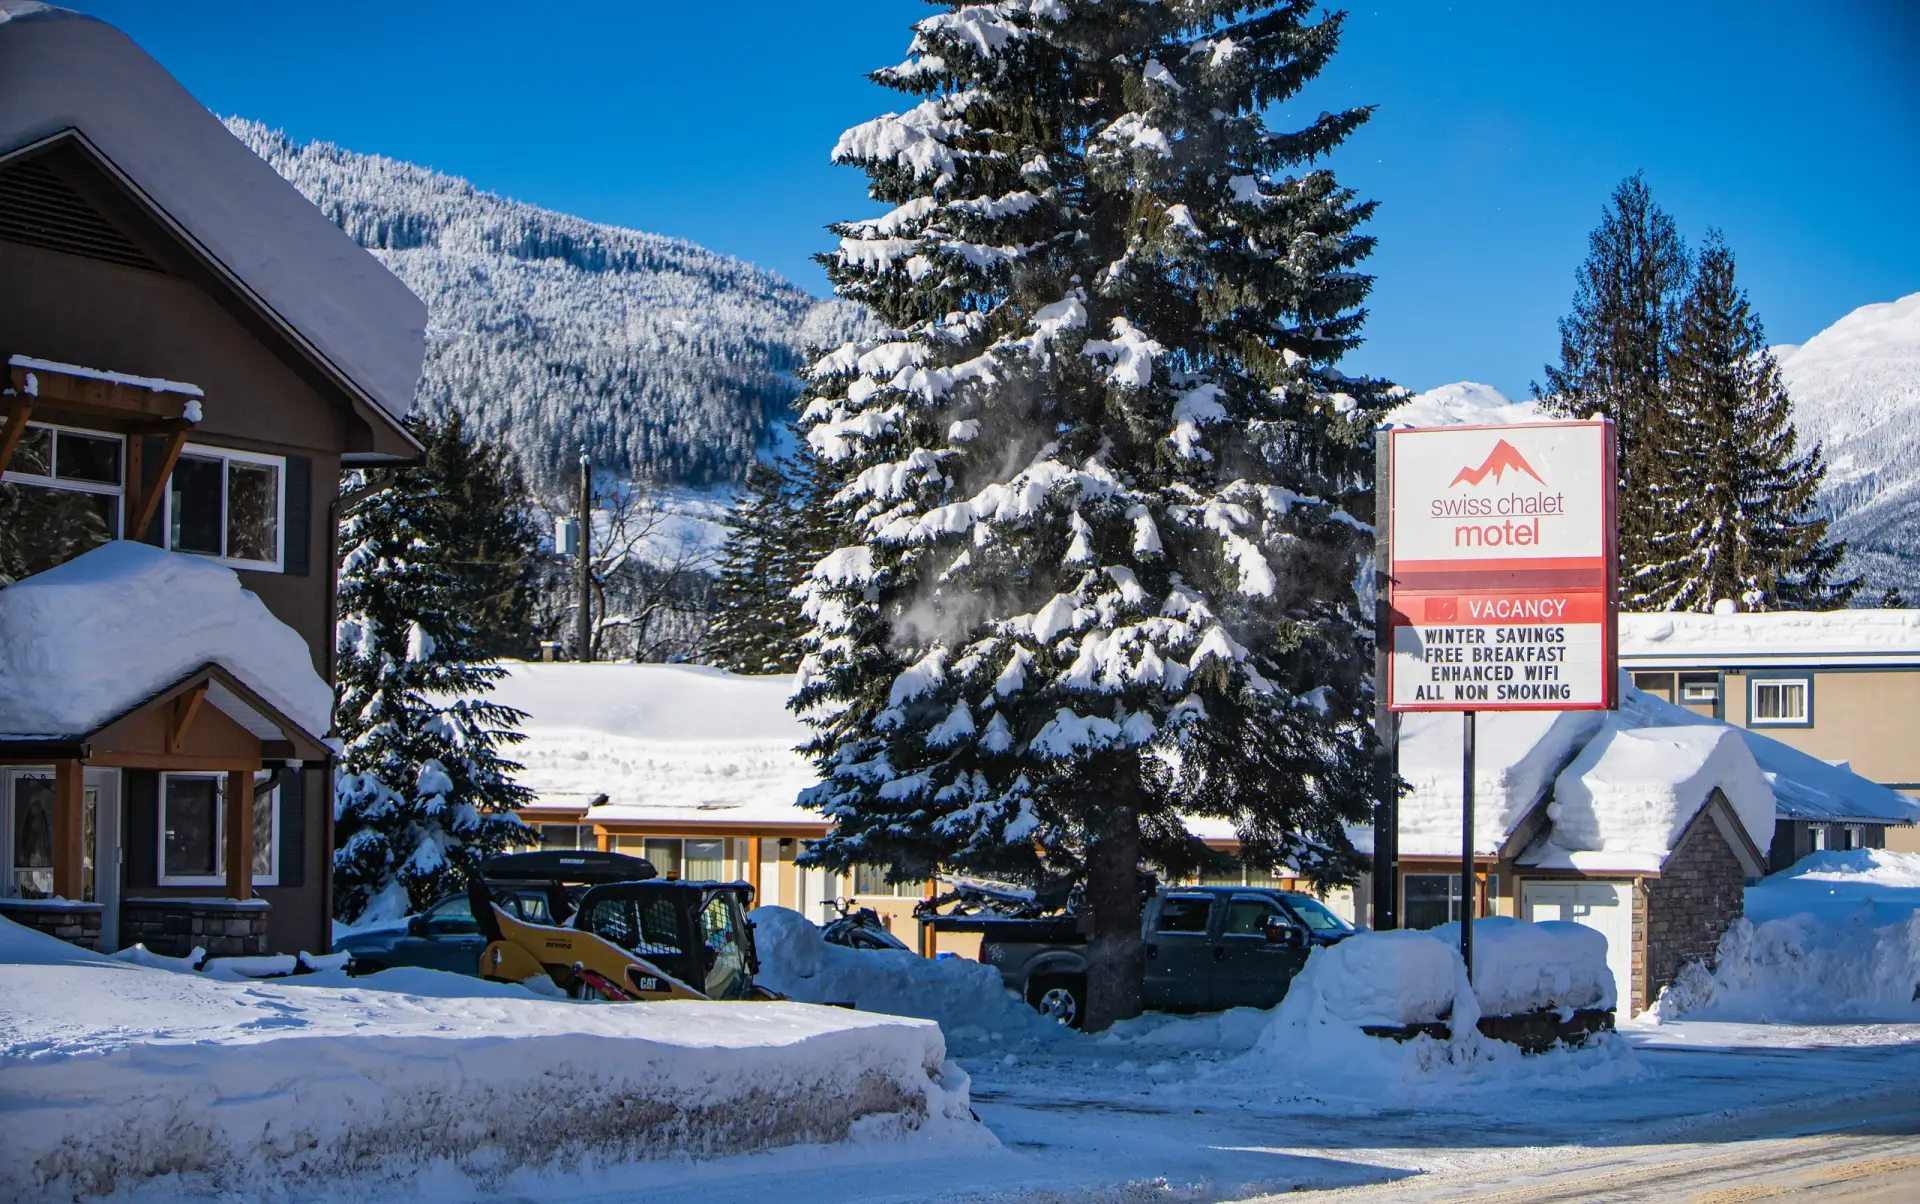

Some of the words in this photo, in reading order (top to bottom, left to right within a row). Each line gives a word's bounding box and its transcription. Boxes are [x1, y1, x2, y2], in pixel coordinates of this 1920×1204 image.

[1431, 493, 1492, 516] swiss
[1497, 491, 1564, 515] chalet
[1455, 517, 1539, 547] motel
[1469, 598, 1567, 618] VACANCY
[1424, 628, 1486, 644] WINTER
[1496, 627, 1565, 643] SAVINGS
[1424, 647, 1464, 663] FREE
[1472, 646, 1567, 662] BREAKFAST
[1431, 665, 1514, 681] ENHANCED
[1524, 665, 1559, 681] WIFI
[1415, 684, 1445, 700] ALL
[1454, 684, 1489, 700] NON
[1496, 683, 1571, 700] SMOKING
[640, 977, 657, 990] CAT
